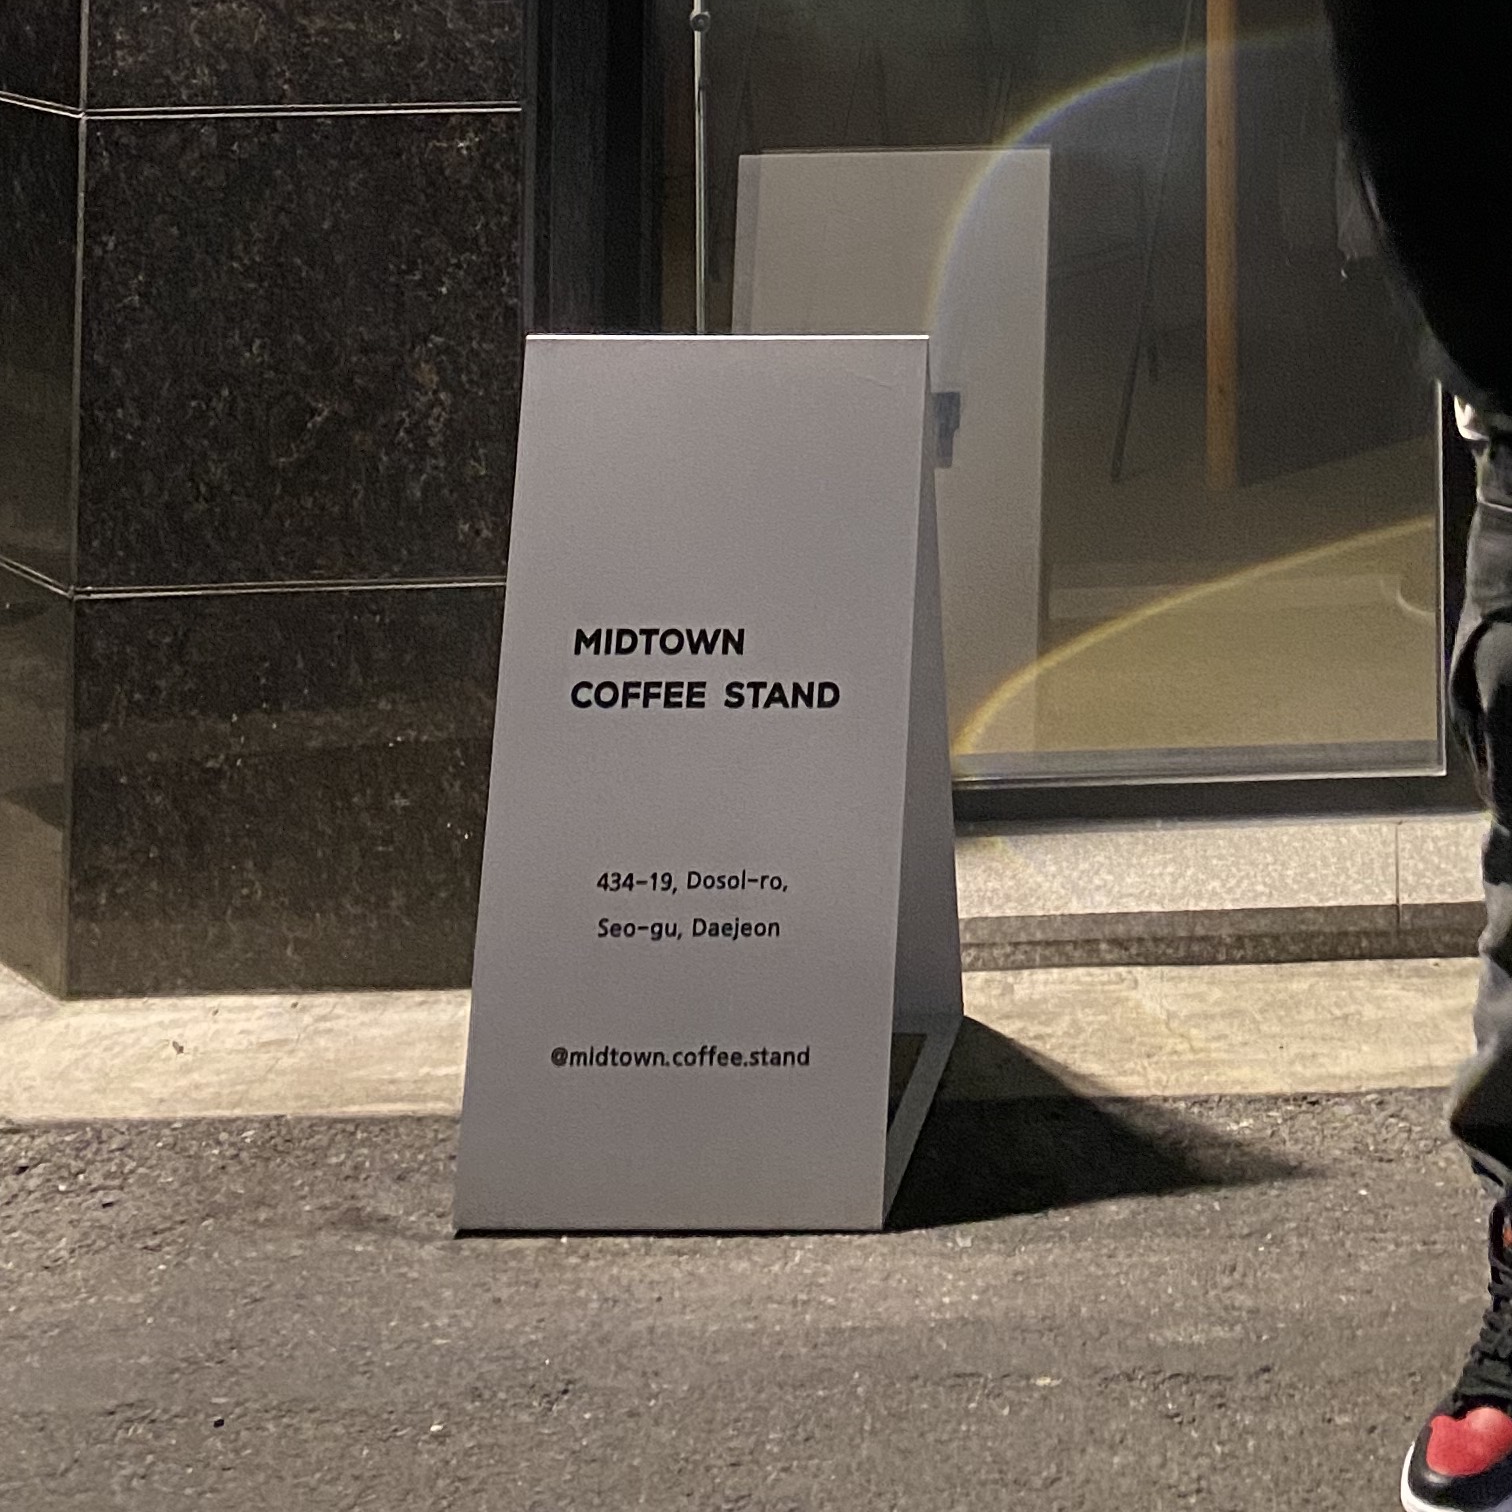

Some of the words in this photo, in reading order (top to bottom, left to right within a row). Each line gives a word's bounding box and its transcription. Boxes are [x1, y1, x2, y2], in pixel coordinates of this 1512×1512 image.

[573, 627, 746, 657] MIDTOWN
[570, 680, 707, 710] COFFEE
[723, 680, 842, 710] STAND
[596, 871, 679, 896] 434-19,
[686, 868, 789, 893] Dosol-ro,
[597, 917, 684, 942] Seo-gu,
[691, 916, 782, 942] Daejeon
[550, 1044, 812, 1069] @midtown.coffee.stand
